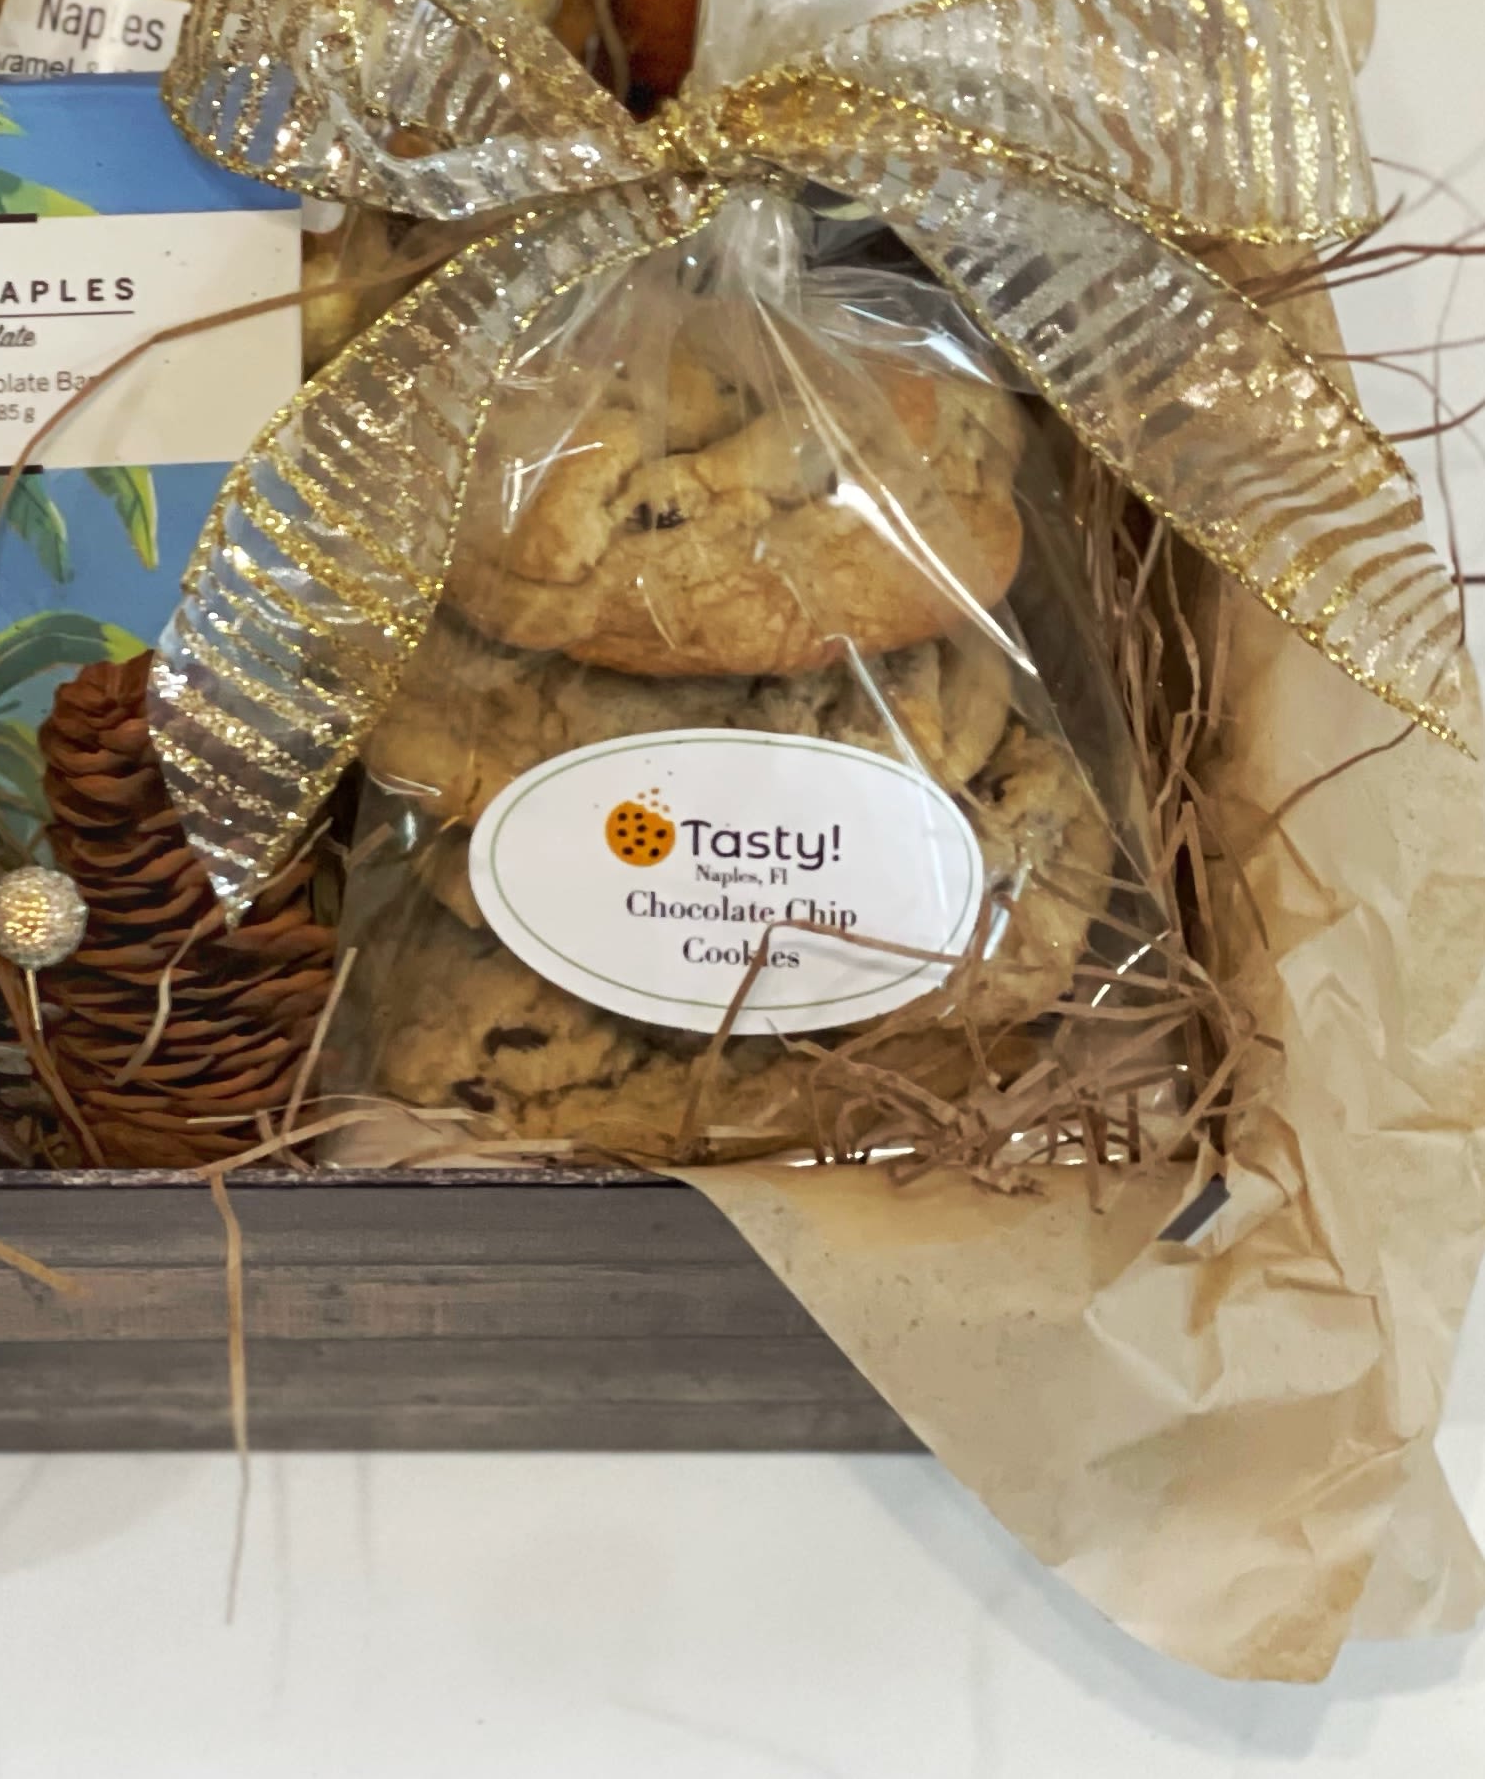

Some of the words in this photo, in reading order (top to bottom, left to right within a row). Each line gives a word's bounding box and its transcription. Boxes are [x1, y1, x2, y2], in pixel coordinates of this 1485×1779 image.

[680, 818, 842, 872] Tasty!
[695, 863, 764, 889] Naples,
[625, 889, 776, 924] Chocolate
[784, 899, 858, 932] Chip
[682, 936, 801, 970] Cookes
